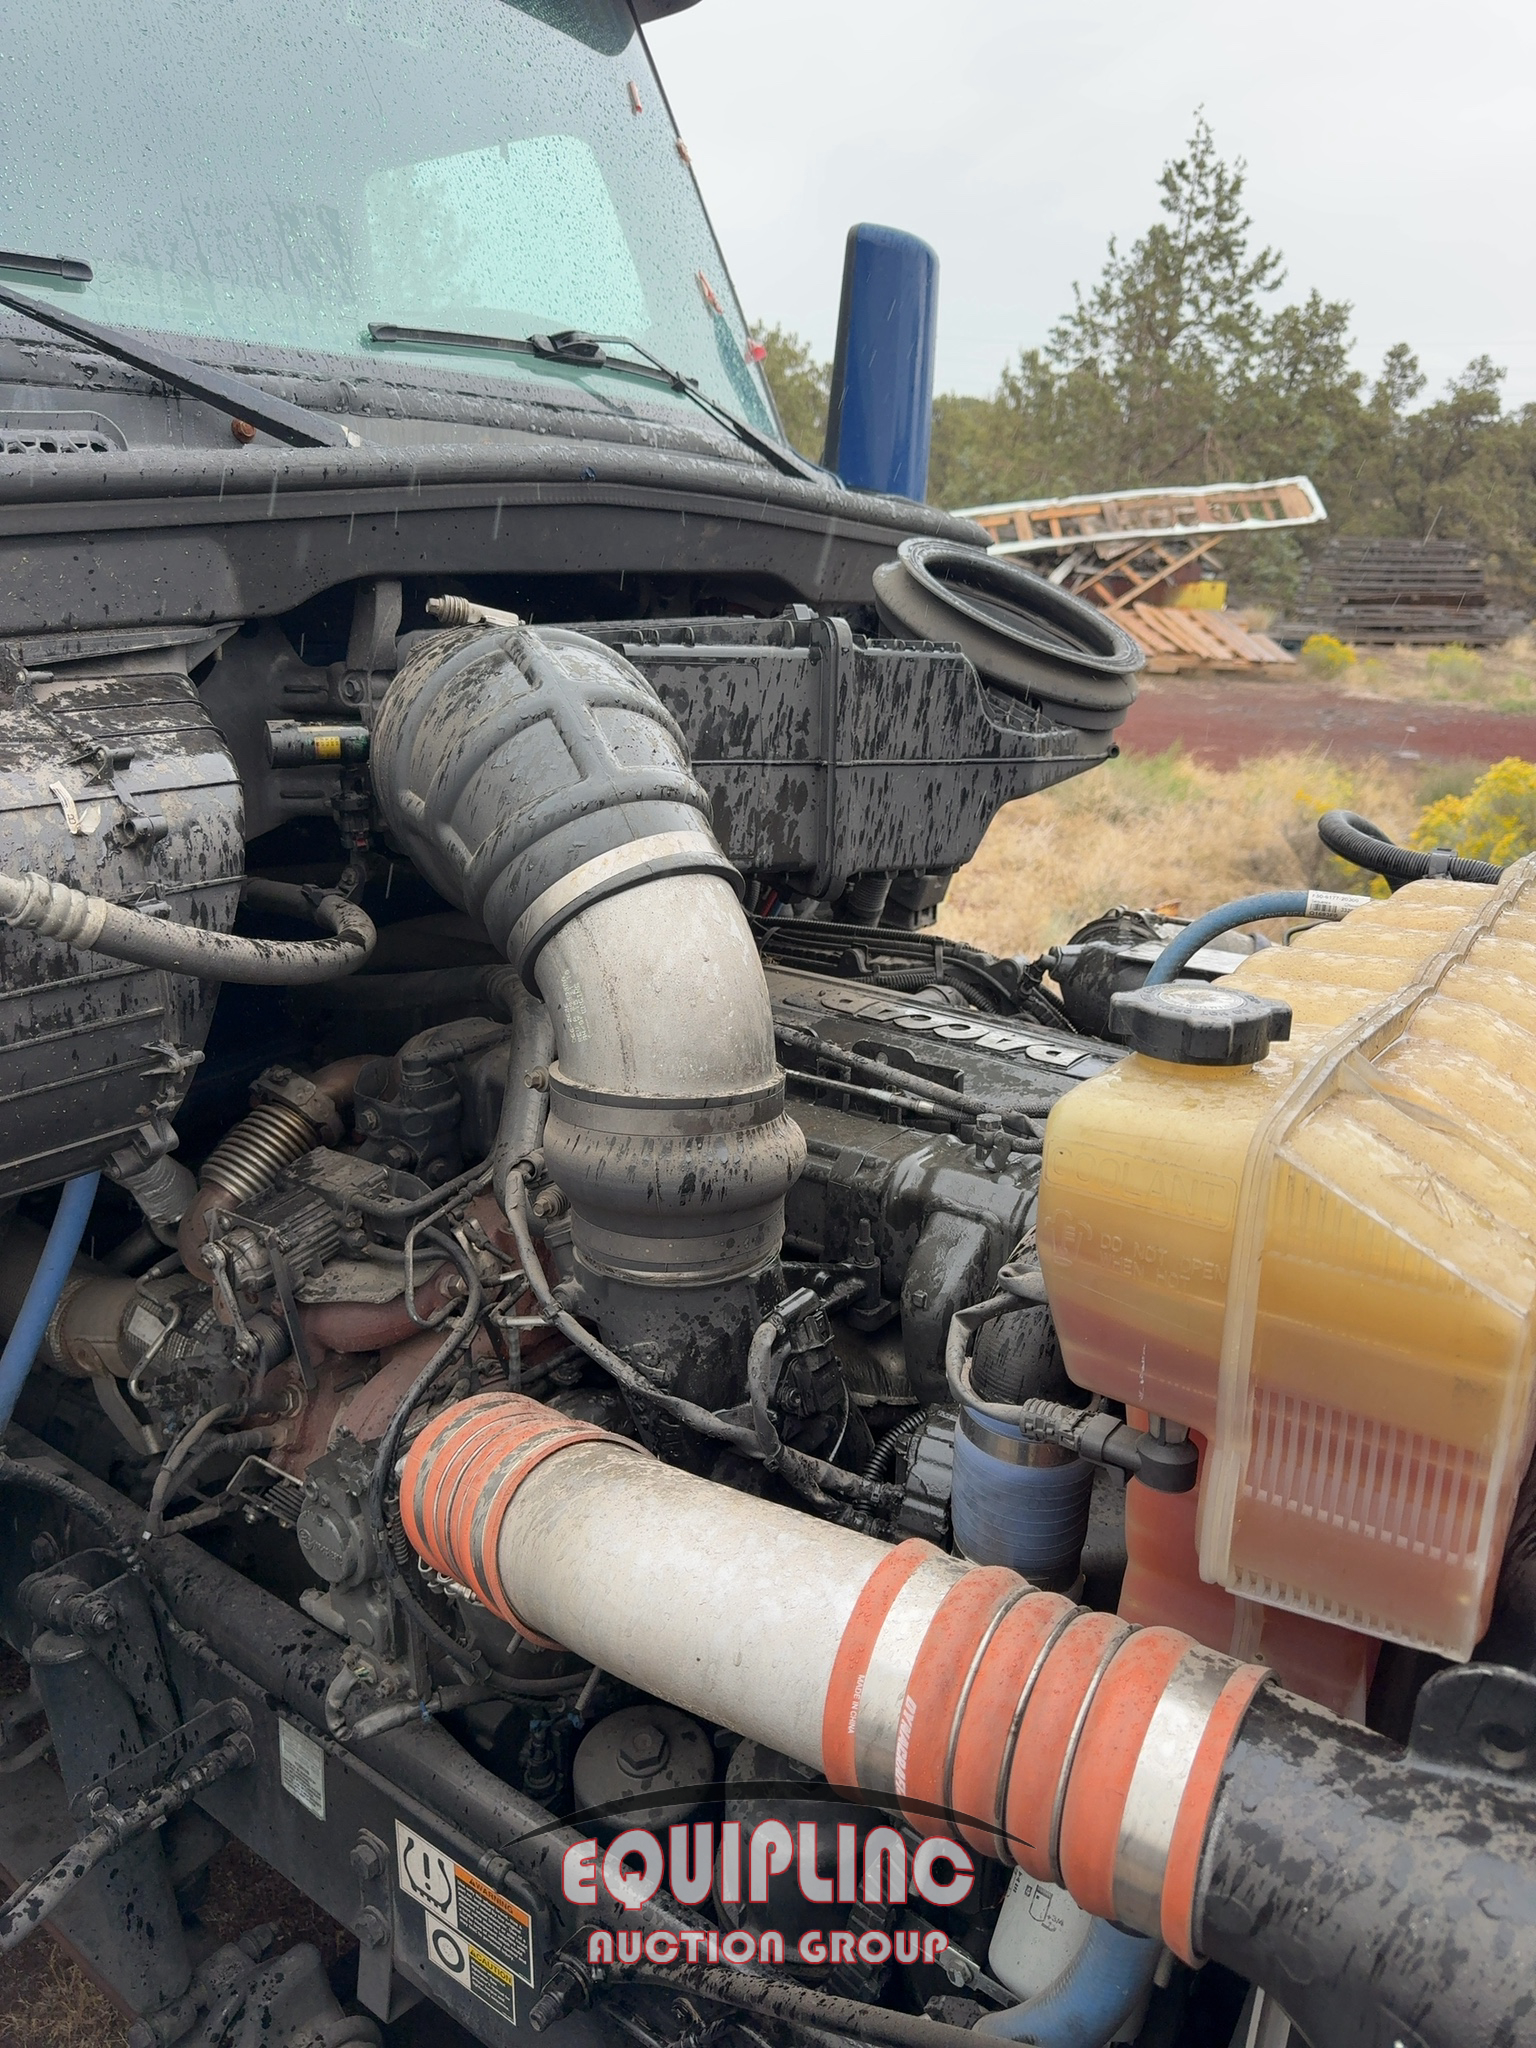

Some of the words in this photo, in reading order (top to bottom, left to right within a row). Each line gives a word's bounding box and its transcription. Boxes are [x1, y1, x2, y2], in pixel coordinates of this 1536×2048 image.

[821, 999, 1091, 1070] PACCAR
[1053, 1147, 1226, 1221] COOLANT
[1100, 1233, 1123, 1251] DO
[1134, 1241, 1168, 1266] NOT
[1180, 1255, 1228, 1284] OPEN
[854, 1674, 865, 1699] MADE
[848, 1709, 857, 1734] CHINA
[851, 1700, 859, 1710] IN
[473, 1880, 514, 1914] WARNING
[475, 1952, 512, 1984] CAUTION
